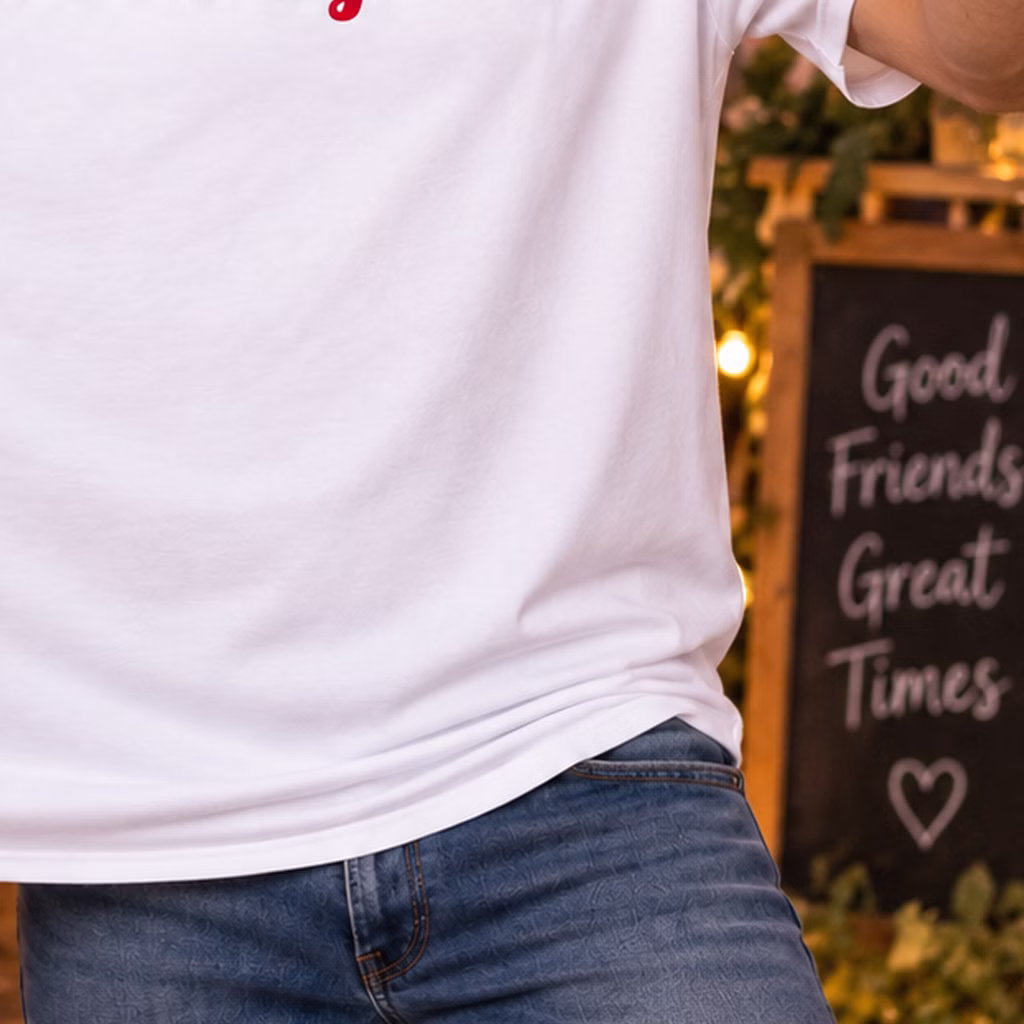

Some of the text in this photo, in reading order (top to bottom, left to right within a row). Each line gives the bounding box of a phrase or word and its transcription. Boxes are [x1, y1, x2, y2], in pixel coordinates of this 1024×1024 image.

[862, 313, 1014, 420] Good
[829, 418, 1024, 517] Friends
[838, 525, 1010, 628] Great
[826, 638, 1010, 731] Times
